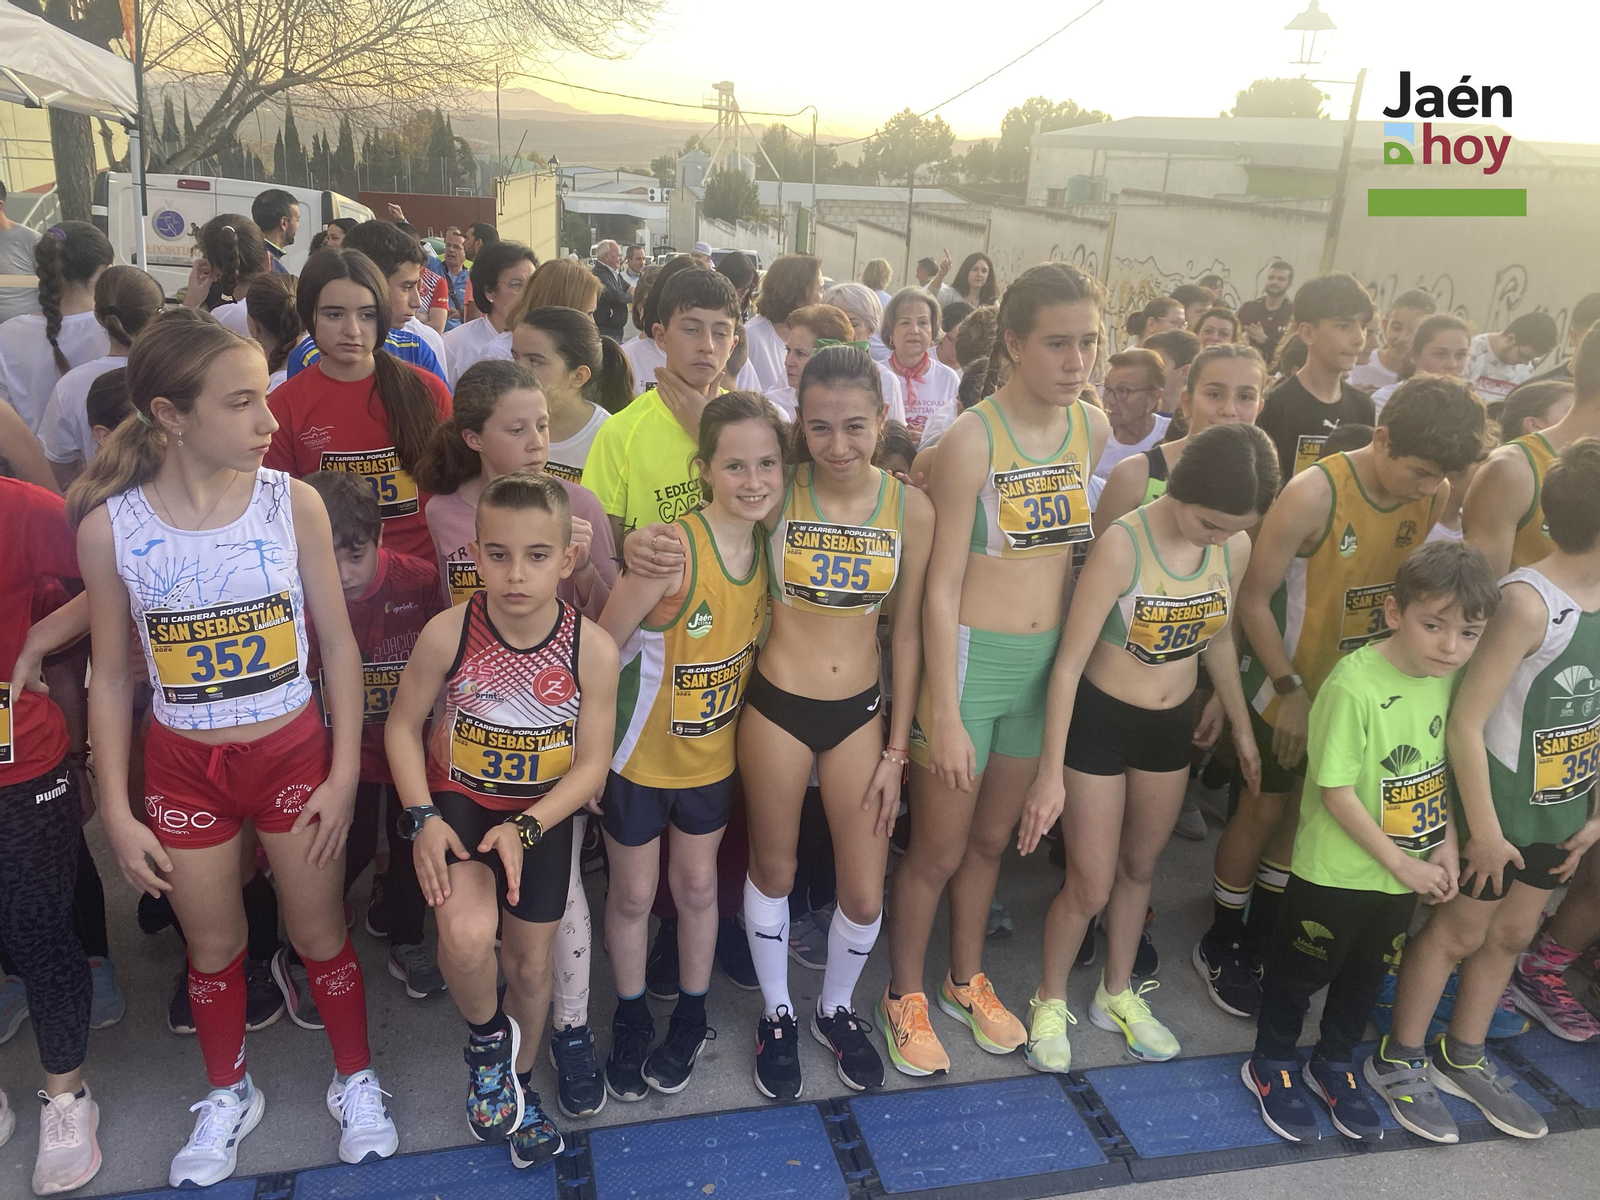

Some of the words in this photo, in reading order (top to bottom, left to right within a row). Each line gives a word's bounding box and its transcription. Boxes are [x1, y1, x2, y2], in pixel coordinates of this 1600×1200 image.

[348, 453, 401, 474] SEBASTIÁ
[366, 451, 395, 460] POPULAR
[1009, 471, 1041, 482] CARRERA
[1041, 468, 1065, 476] POPULAR
[654, 489, 663, 502] I
[664, 478, 700, 499] EDICI
[1000, 480, 1025, 498] SAN
[1023, 494, 1071, 531] 350
[808, 526, 842, 535] CARRERA
[844, 529, 877, 538] POPULAR
[793, 531, 820, 548] SAN
[822, 533, 890, 553] SEBASTIÁN
[454, 571, 477, 586] SAN
[809, 553, 872, 591] 355
[1189, 596, 1213, 606] POPULAR
[1352, 594, 1373, 609] SAN
[160, 616, 169, 624] III
[171, 611, 217, 623] CARRERA
[219, 602, 265, 617] POPULAR
[1142, 606, 1168, 621] SAN
[157, 623, 191, 642] SAN
[194, 603, 285, 639] SEBASTIÁN
[254, 615, 290, 631] LAHIGUERA
[1153, 621, 1206, 651] 368
[186, 635, 270, 683] 352
[695, 663, 726, 673] CARRERA
[682, 673, 708, 689] SAN
[460, 722, 486, 744] SAN
[488, 726, 566, 750] SEBASTIÁN
[473, 720, 510, 734] CARRERA
[512, 727, 553, 735] POPULAR
[1555, 727, 1587, 738] CARRERA
[1542, 737, 1569, 755] SAN
[480, 749, 540, 782] 331
[1561, 743, 1600, 785] 358
[1403, 773, 1431, 786] CARRERA
[35, 783, 67, 805] PUMA
[1391, 785, 1416, 802] SAN
